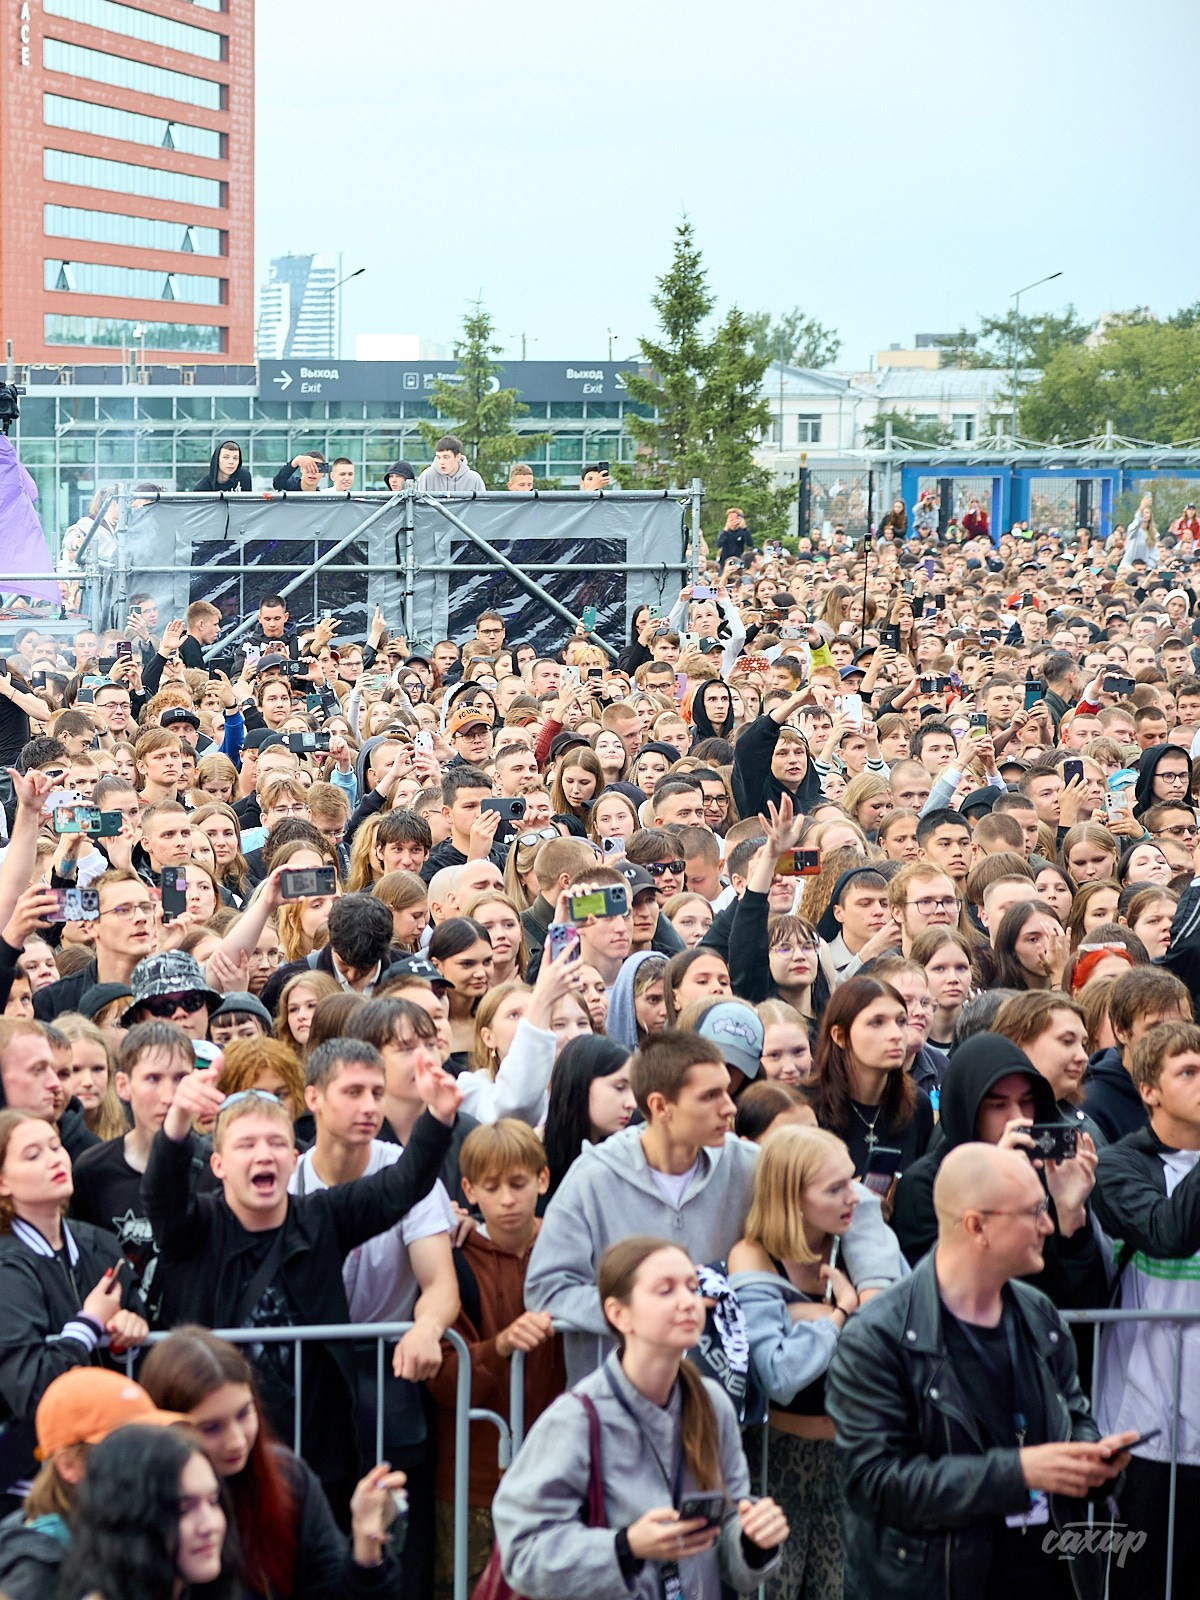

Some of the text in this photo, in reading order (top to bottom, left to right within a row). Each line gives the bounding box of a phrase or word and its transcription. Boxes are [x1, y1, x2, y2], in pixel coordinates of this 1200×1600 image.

[300, 367, 340, 380] Выход
[566, 368, 604, 381] Выход
[301, 382, 322, 394] Exit
[582, 383, 604, 394] Exit
